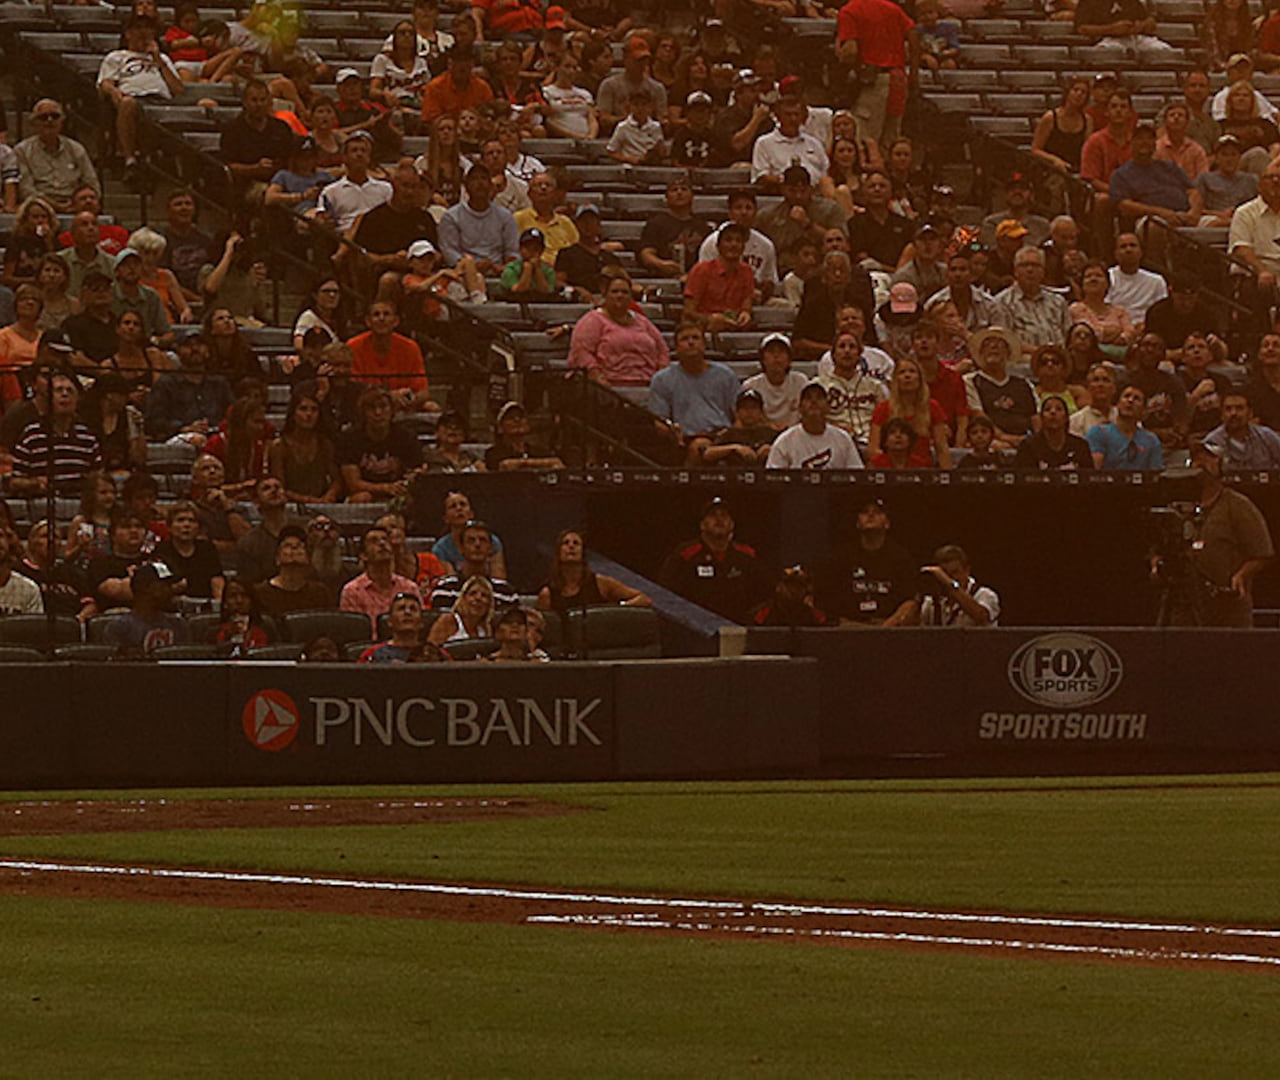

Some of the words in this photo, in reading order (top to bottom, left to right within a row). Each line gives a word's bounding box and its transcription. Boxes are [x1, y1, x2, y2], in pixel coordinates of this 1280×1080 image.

[1033, 648, 1097, 678] FOX
[1033, 679, 1099, 693] SPORTS
[978, 712, 1148, 740] SPORTSOUTH
